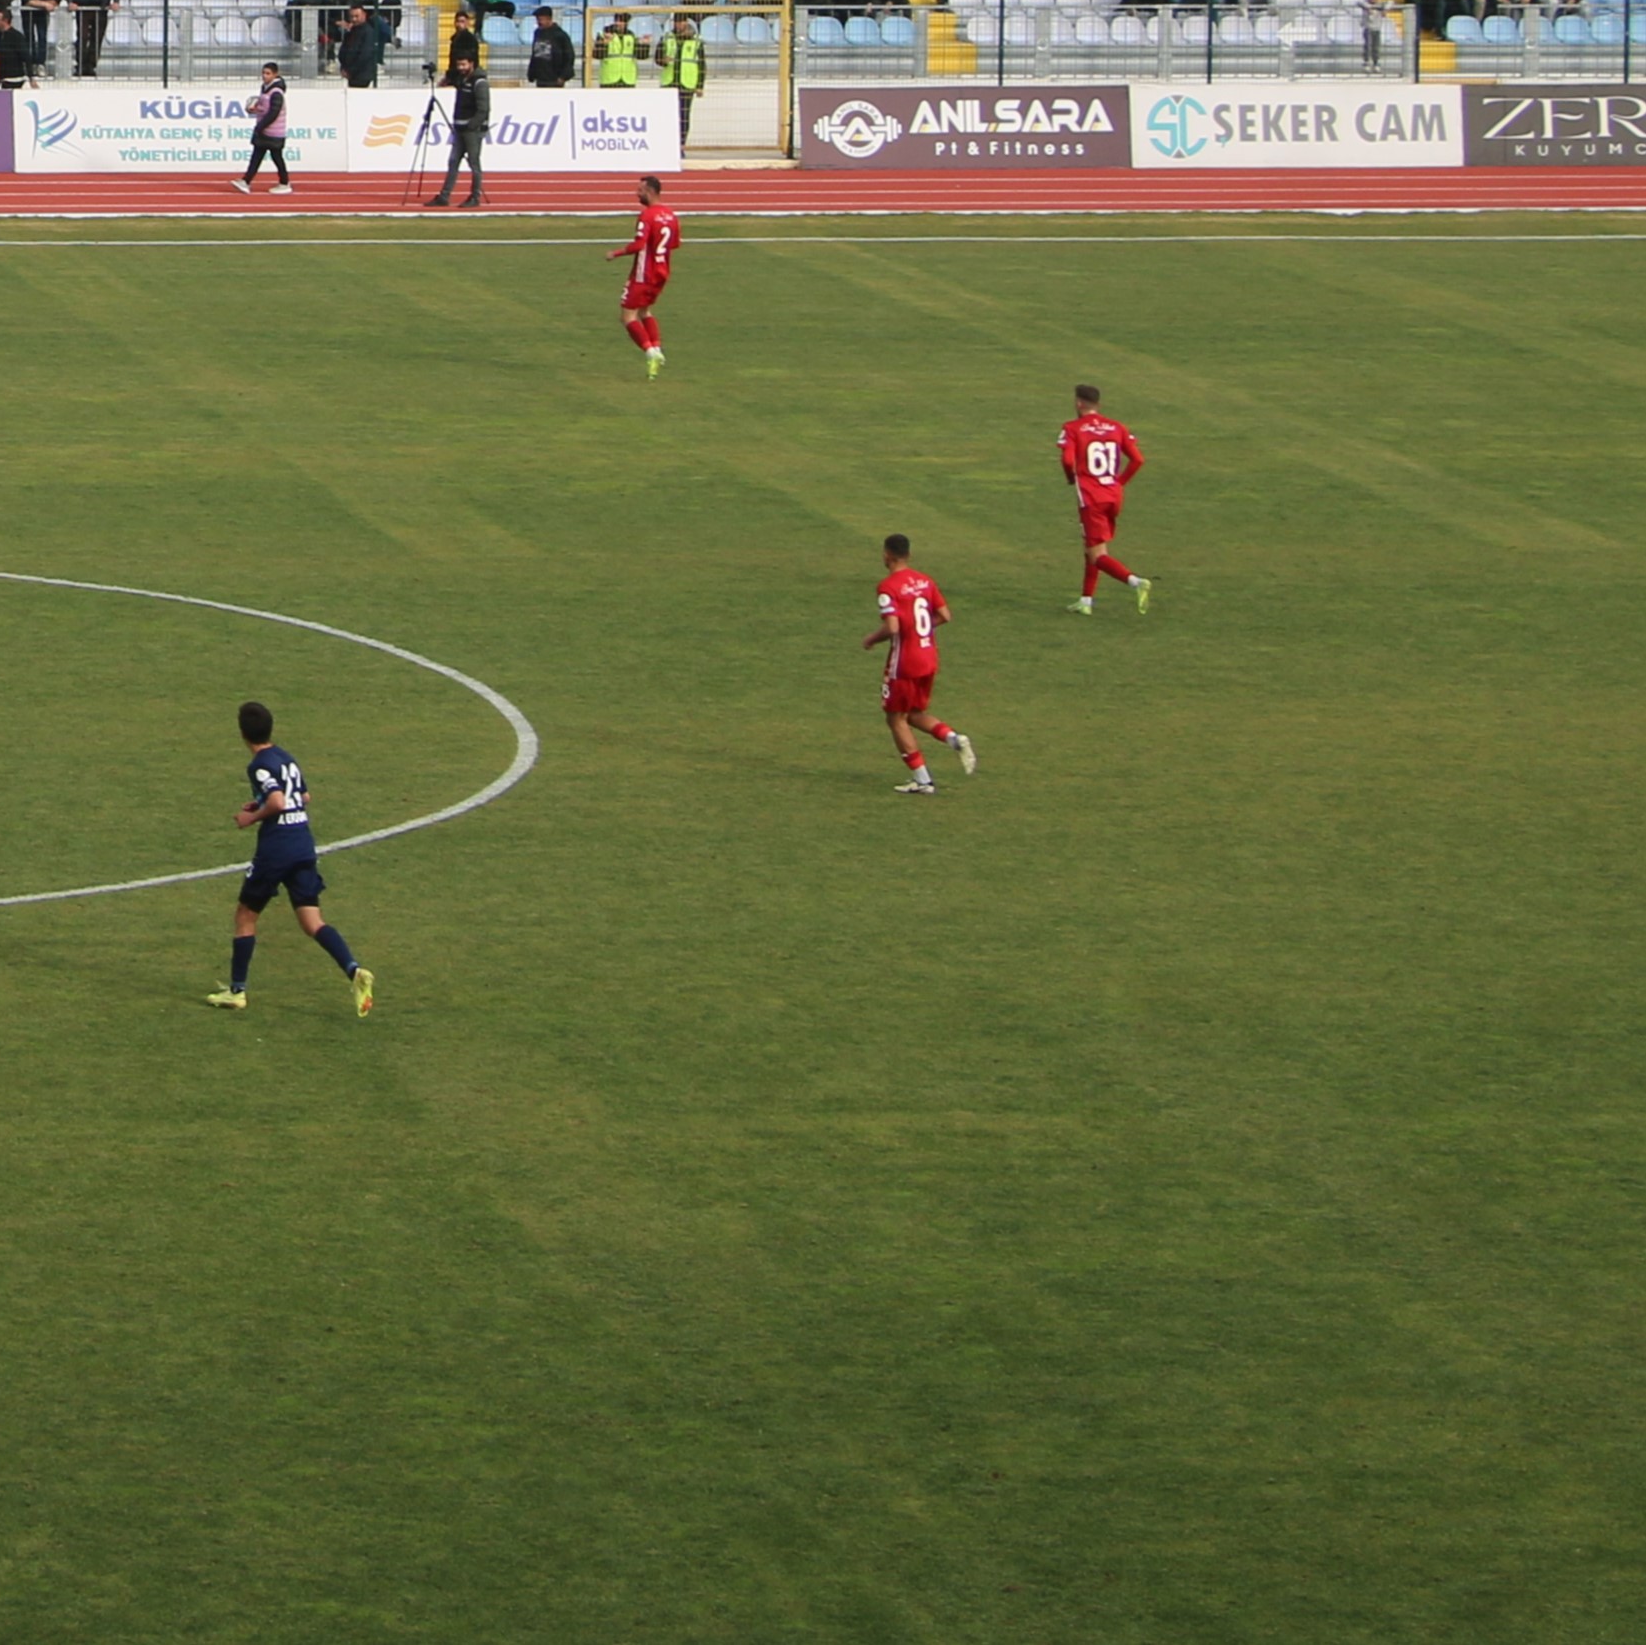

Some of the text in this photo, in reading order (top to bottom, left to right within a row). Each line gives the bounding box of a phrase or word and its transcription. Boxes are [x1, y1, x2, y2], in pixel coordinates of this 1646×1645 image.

[582, 109, 647, 133] aksu
[1212, 103, 1447, 147] ŞEKER CAM
[81, 125, 337, 143] KÜTAHYA GENÇ İŞ İNSARI VE
[118, 146, 301, 162] YÖNETİCİLERİ DEĞİ
[935, 140, 1085, 155] Pt & Fitness
[1514, 143, 1646, 156] KUYUMC
[656, 226, 671, 254] 2
[1087, 441, 1117, 476] 61
[913, 596, 931, 637] 6
